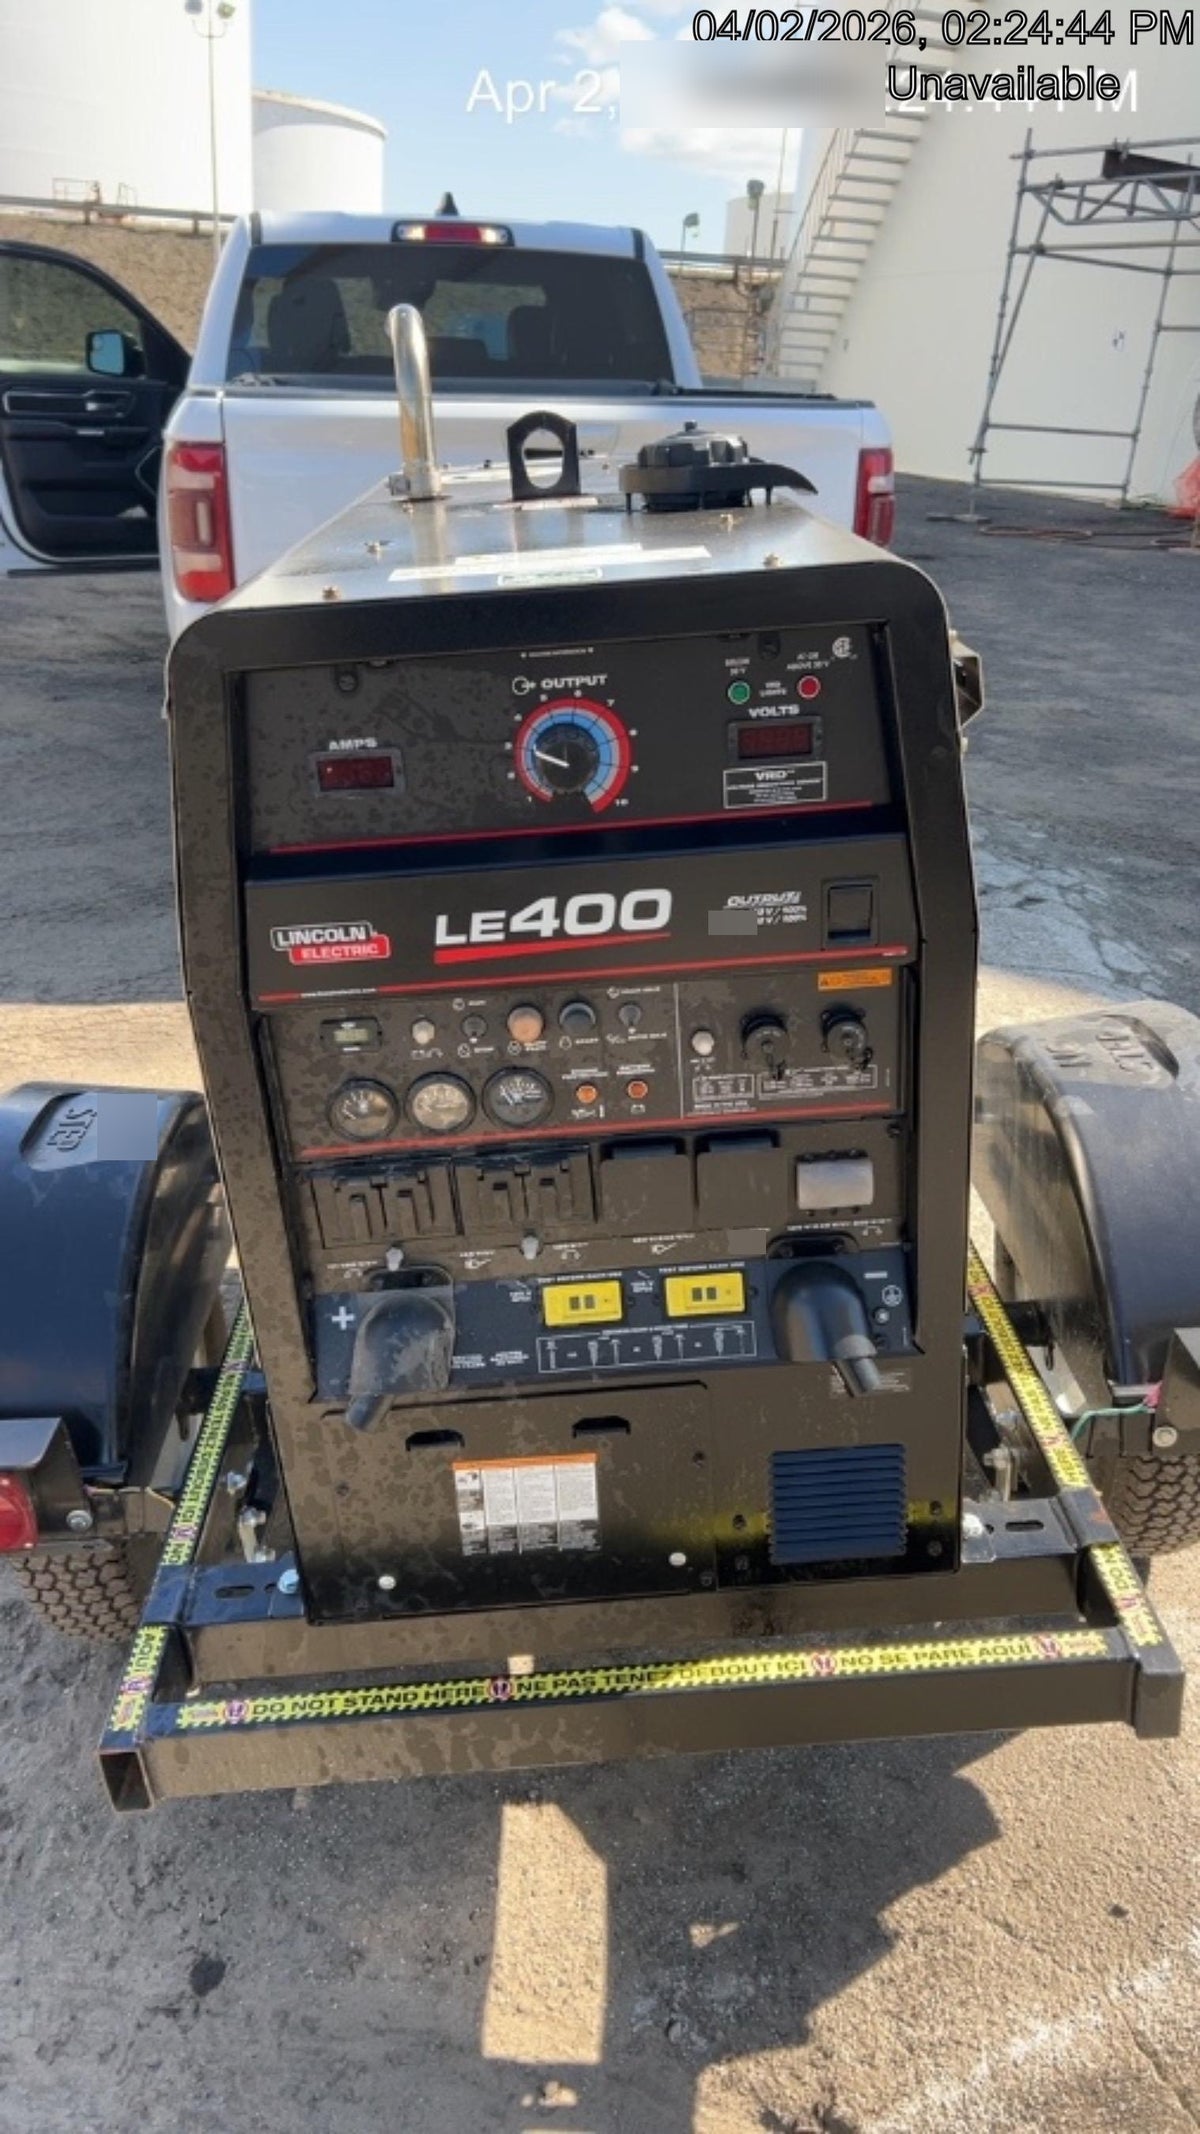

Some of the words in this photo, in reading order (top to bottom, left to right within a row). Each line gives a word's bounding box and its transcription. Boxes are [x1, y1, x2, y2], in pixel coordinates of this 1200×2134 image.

[540, 675, 607, 689] OUTPUT
[748, 704, 799, 718] VOLTS
[328, 737, 378, 751] AMPS
[434, 888, 673, 946] LE400
[276, 926, 367, 947] LINCOLN
[302, 943, 379, 959] ELECTRIC
[253, 1703, 285, 1715] DO
[291, 1700, 335, 1713] NOT
[343, 1688, 418, 1709] STAND
[423, 1686, 484, 1700] HERE
[517, 1678, 548, 1692] NE
[553, 1675, 596, 1690] PAS
[604, 1671, 672, 1687] TENEZ
[679, 1662, 772, 1680] DEBOUT
[777, 1661, 806, 1673] ICI
[840, 1655, 874, 1667] NO
[879, 1653, 909, 1666] SE
[913, 1648, 974, 1662] PARE
[979, 1643, 1032, 1658] AQUI
